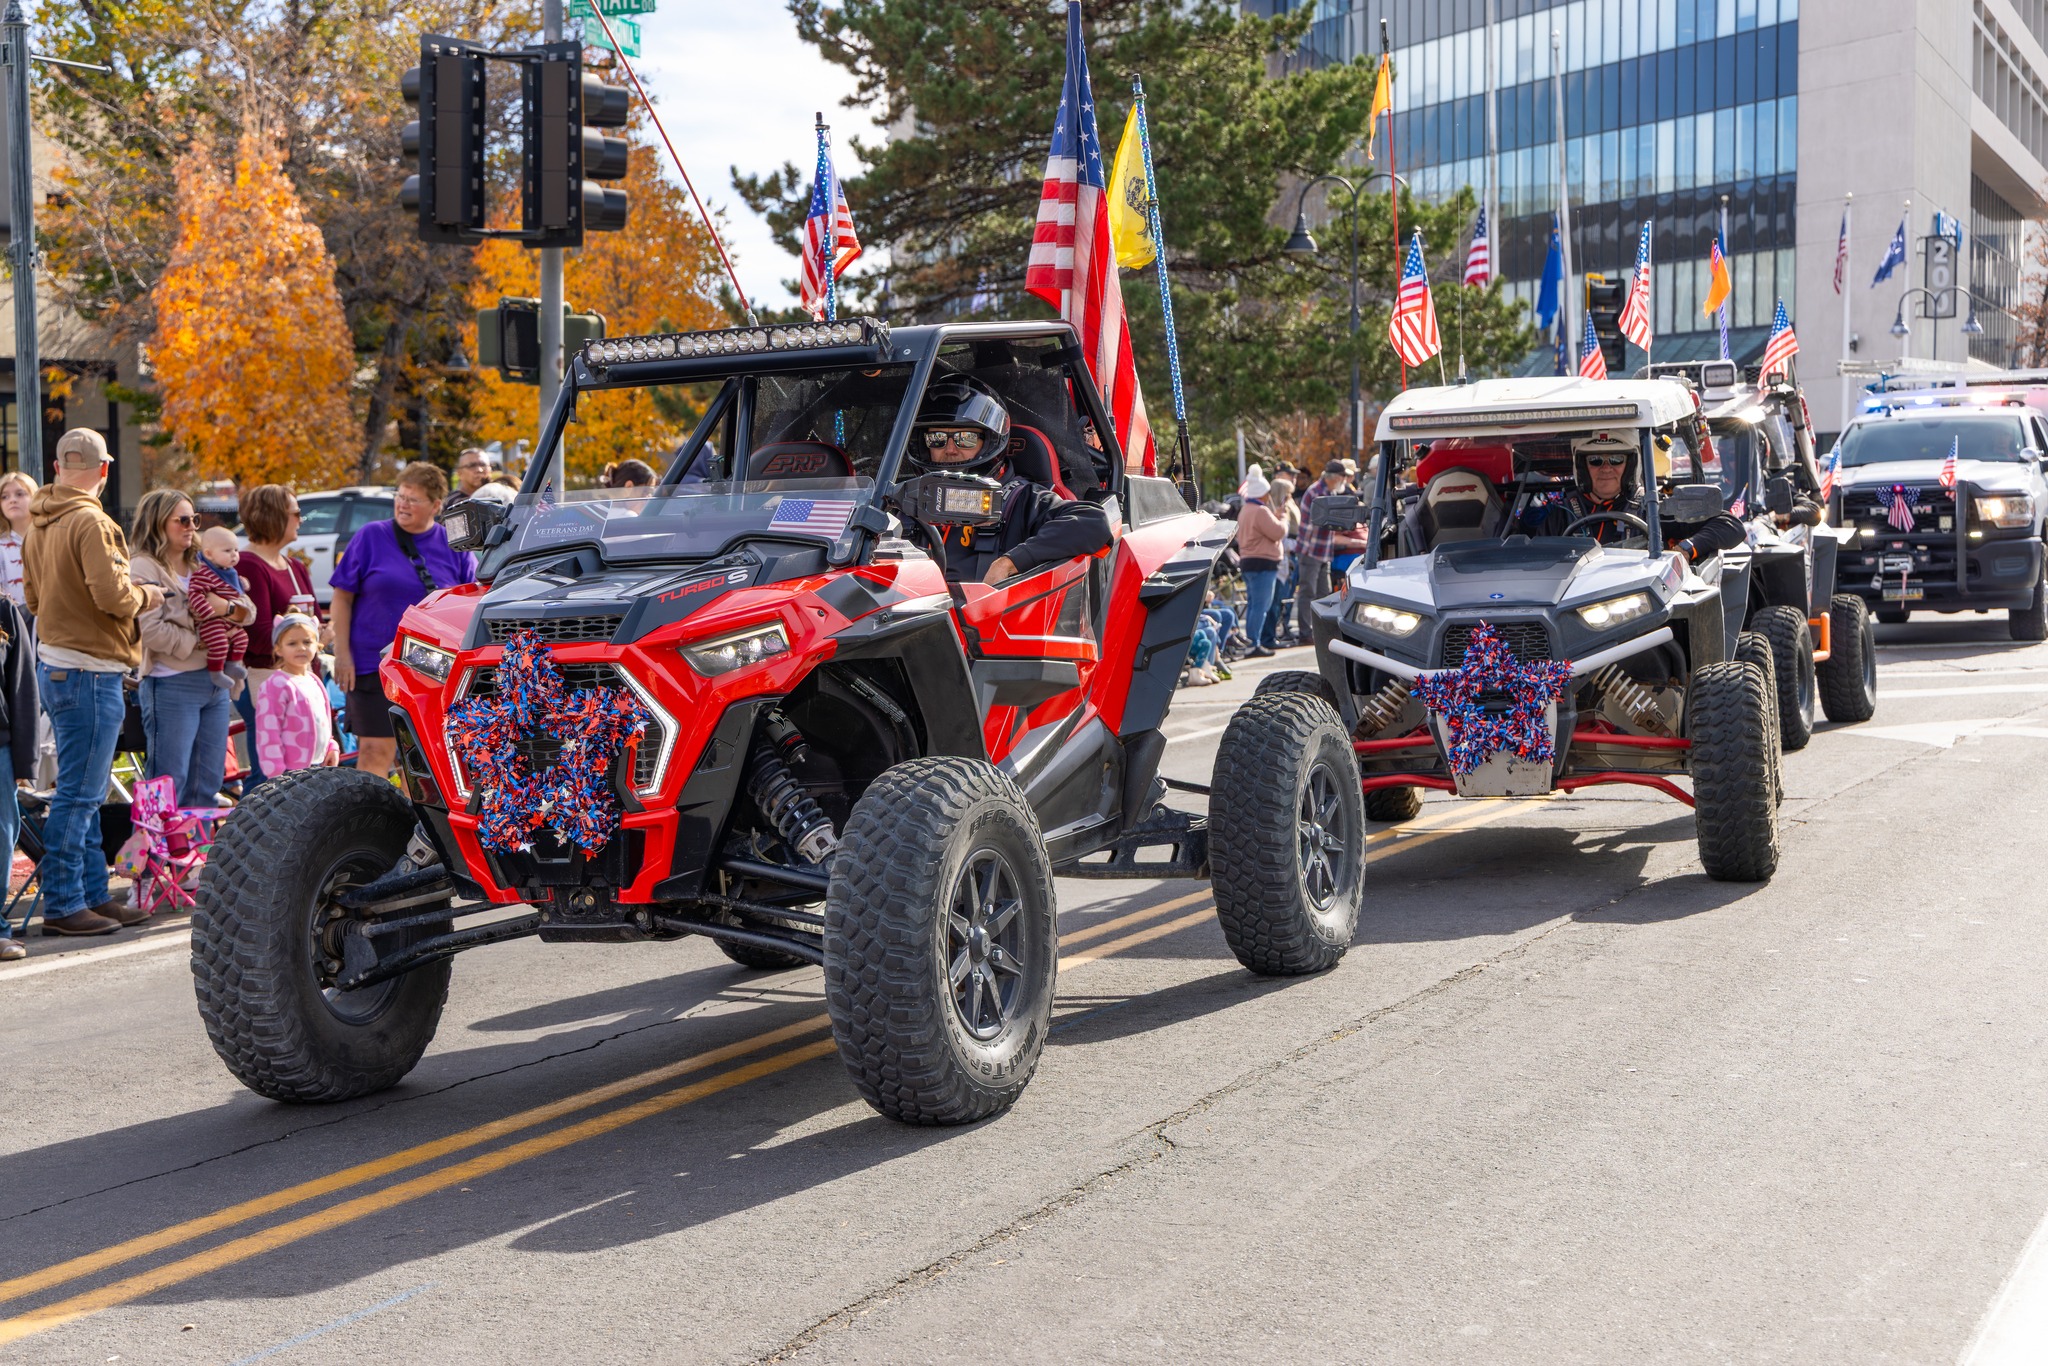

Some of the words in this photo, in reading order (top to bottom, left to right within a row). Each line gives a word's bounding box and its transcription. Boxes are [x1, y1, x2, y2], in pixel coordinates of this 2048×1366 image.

[535, 526, 578, 536] VETERANS
[578, 524, 596, 533] DAY
[657, 575, 726, 604] TURBO
[727, 569, 749, 585] S
